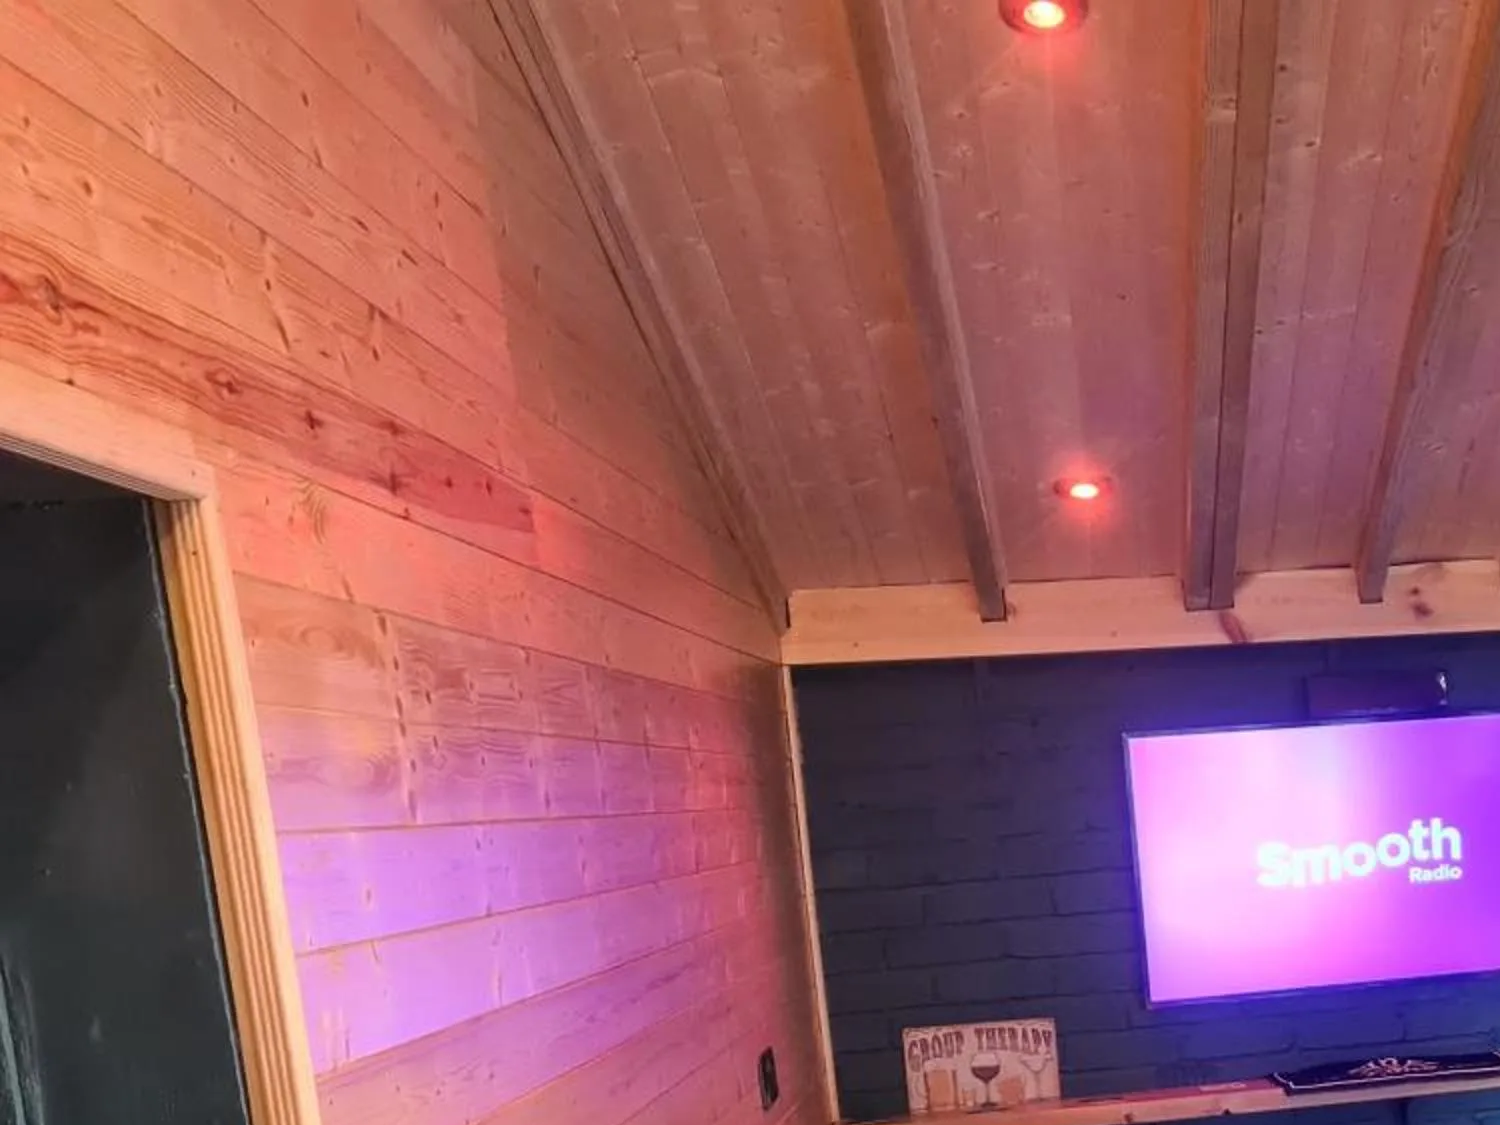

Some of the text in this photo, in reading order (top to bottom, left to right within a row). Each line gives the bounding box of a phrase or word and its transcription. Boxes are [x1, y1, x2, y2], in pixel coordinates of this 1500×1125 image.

[1257, 817, 1462, 888] Smooth
[1408, 864, 1463, 884] Radio
[907, 1027, 1053, 1062] GROUP THERAPY
